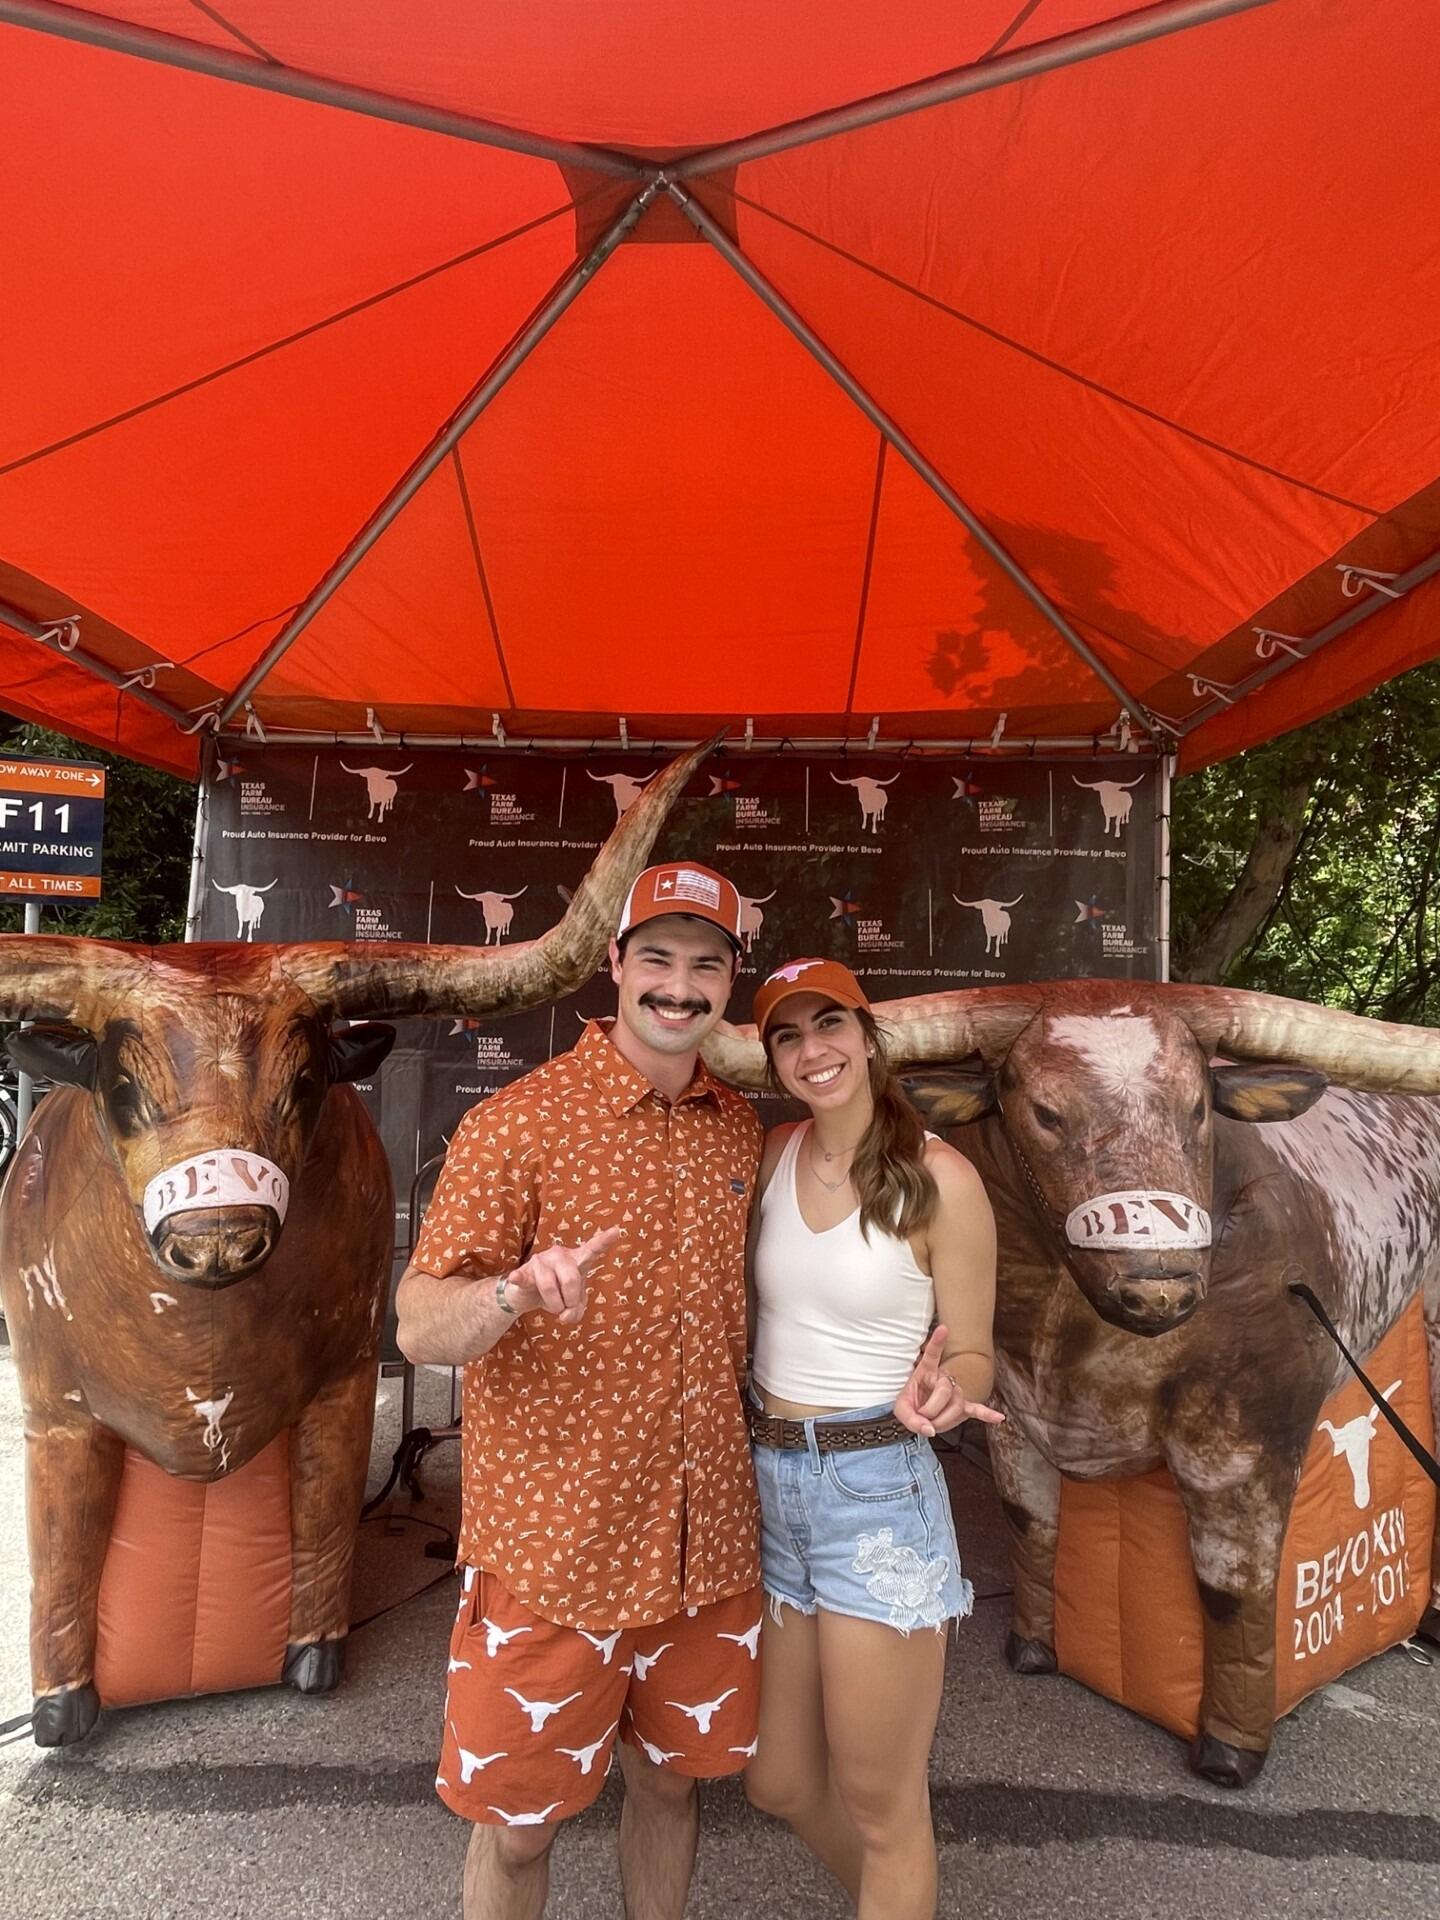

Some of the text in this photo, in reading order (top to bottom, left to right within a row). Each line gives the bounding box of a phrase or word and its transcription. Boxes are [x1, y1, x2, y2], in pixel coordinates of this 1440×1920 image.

[0, 764, 85, 782] OW AWAY ZONE
[241, 782, 266, 790] TEXAS
[241, 789, 263, 797] FARM
[491, 793, 517, 801] TEXAS
[241, 796, 273, 804] BUREAU
[0, 797, 70, 834] F11
[736, 810, 768, 818] BUREAU
[222, 830, 387, 843] Proud Auto Insurance Provider for Bevo
[469, 839, 495, 848] Proud
[497, 840, 516, 848] Auto
[518, 839, 560, 848] Insurance
[562, 840, 598, 849] Provider
[716, 843, 883, 854] Proud Auto Insurance Provider for Bevo
[0, 841, 94, 858] MIT PARKING
[961, 846, 1127, 858] Proud Auto Insurance Provider for Bevo
[8, 877, 83, 892] ALL TIMES
[355, 908, 382, 917] TEXAS
[356, 923, 389, 931] BUREAU
[858, 933, 891, 941] BUREAU
[890, 968, 932, 977] Insurance
[934, 968, 969, 977] Provider
[971, 969, 983, 977] for
[984, 970, 1006, 979] Bevo
[476, 1036, 504, 1045] TEXAS
[477, 1051, 511, 1059] BUREAU
[455, 1085, 500, 1094] Proud Aut
[1296, 1530, 1369, 1609] BEVO
[1294, 1591, 1344, 1660] 2004
